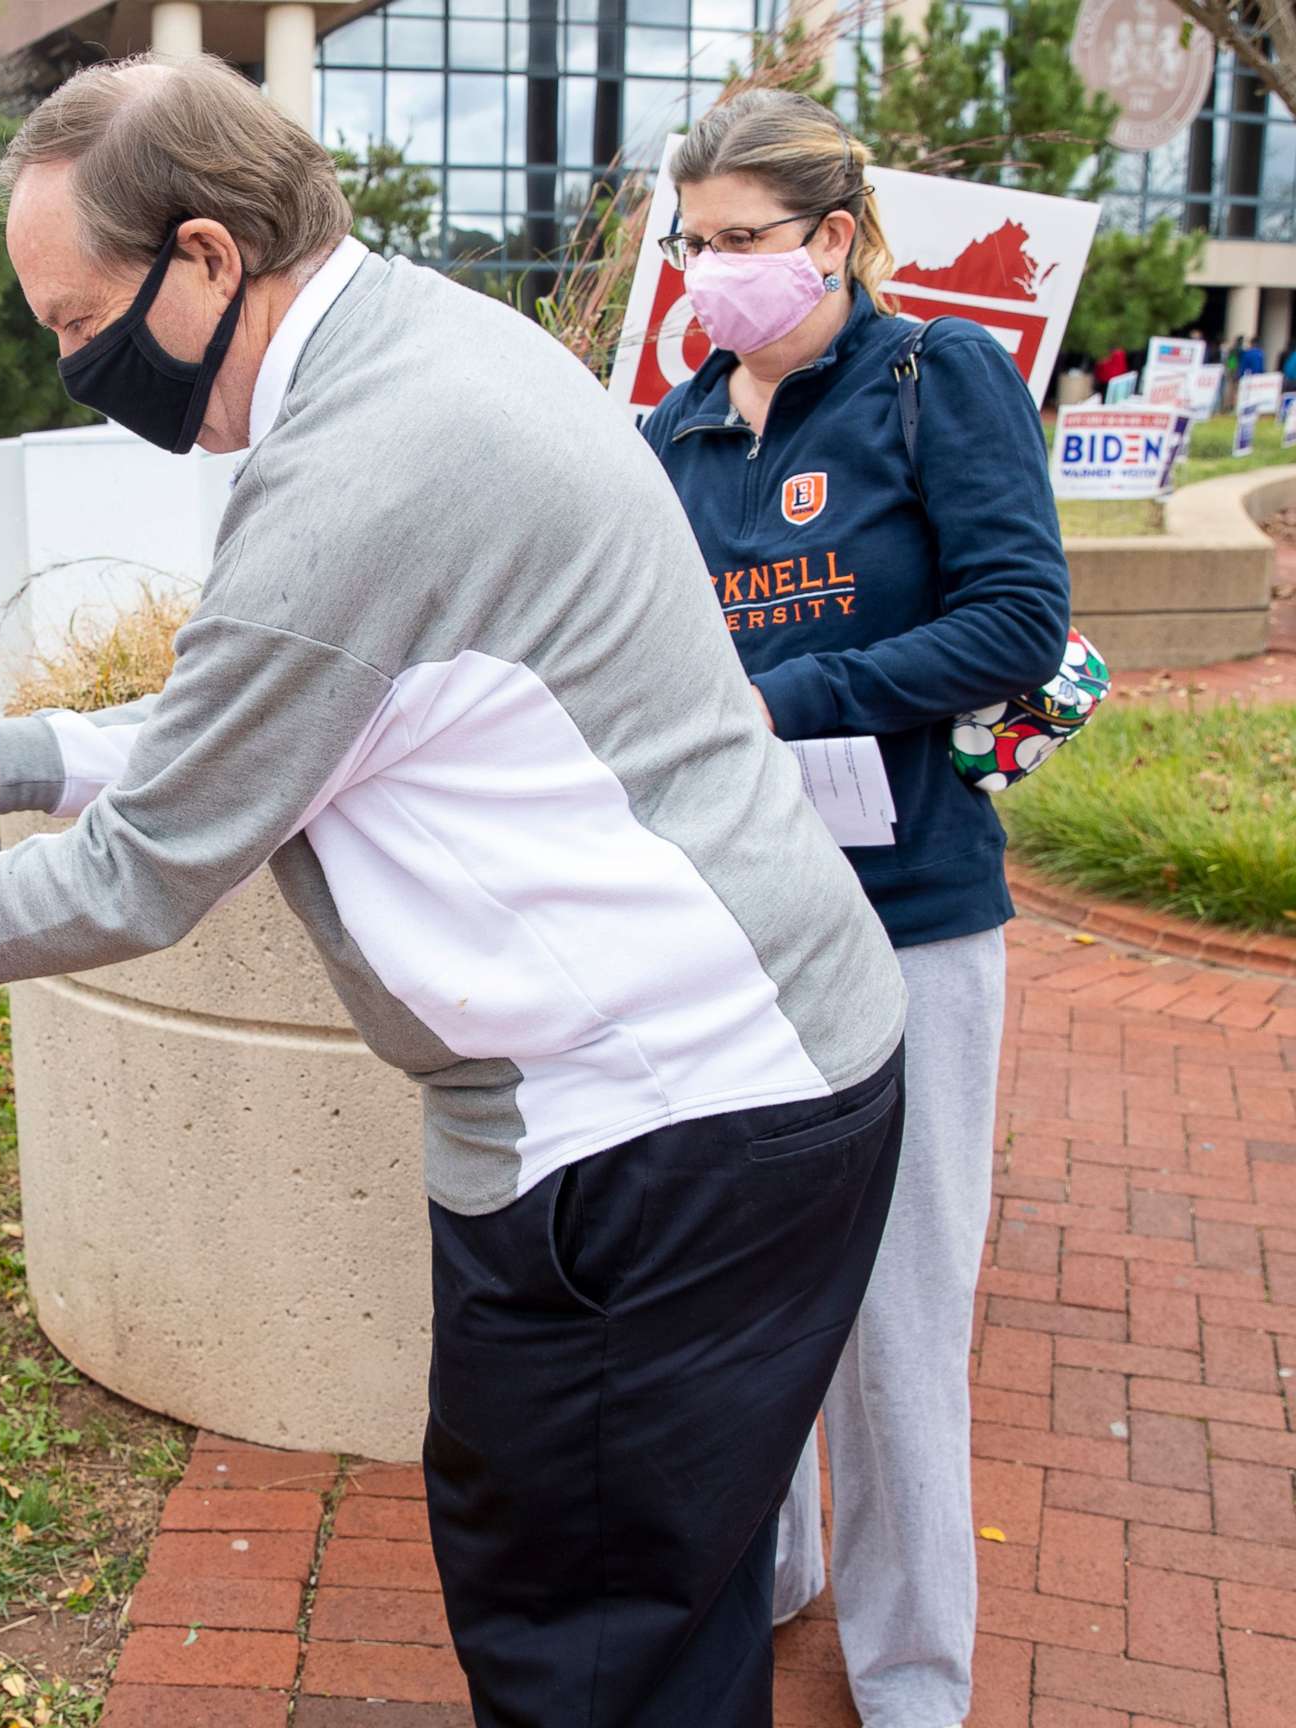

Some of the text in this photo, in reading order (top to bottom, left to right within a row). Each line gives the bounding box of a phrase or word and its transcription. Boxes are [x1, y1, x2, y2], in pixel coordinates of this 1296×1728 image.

[1062, 434, 1163, 463] BIDEN
[710, 552, 855, 604] KNELL
[725, 595, 855, 632] ERSITY
